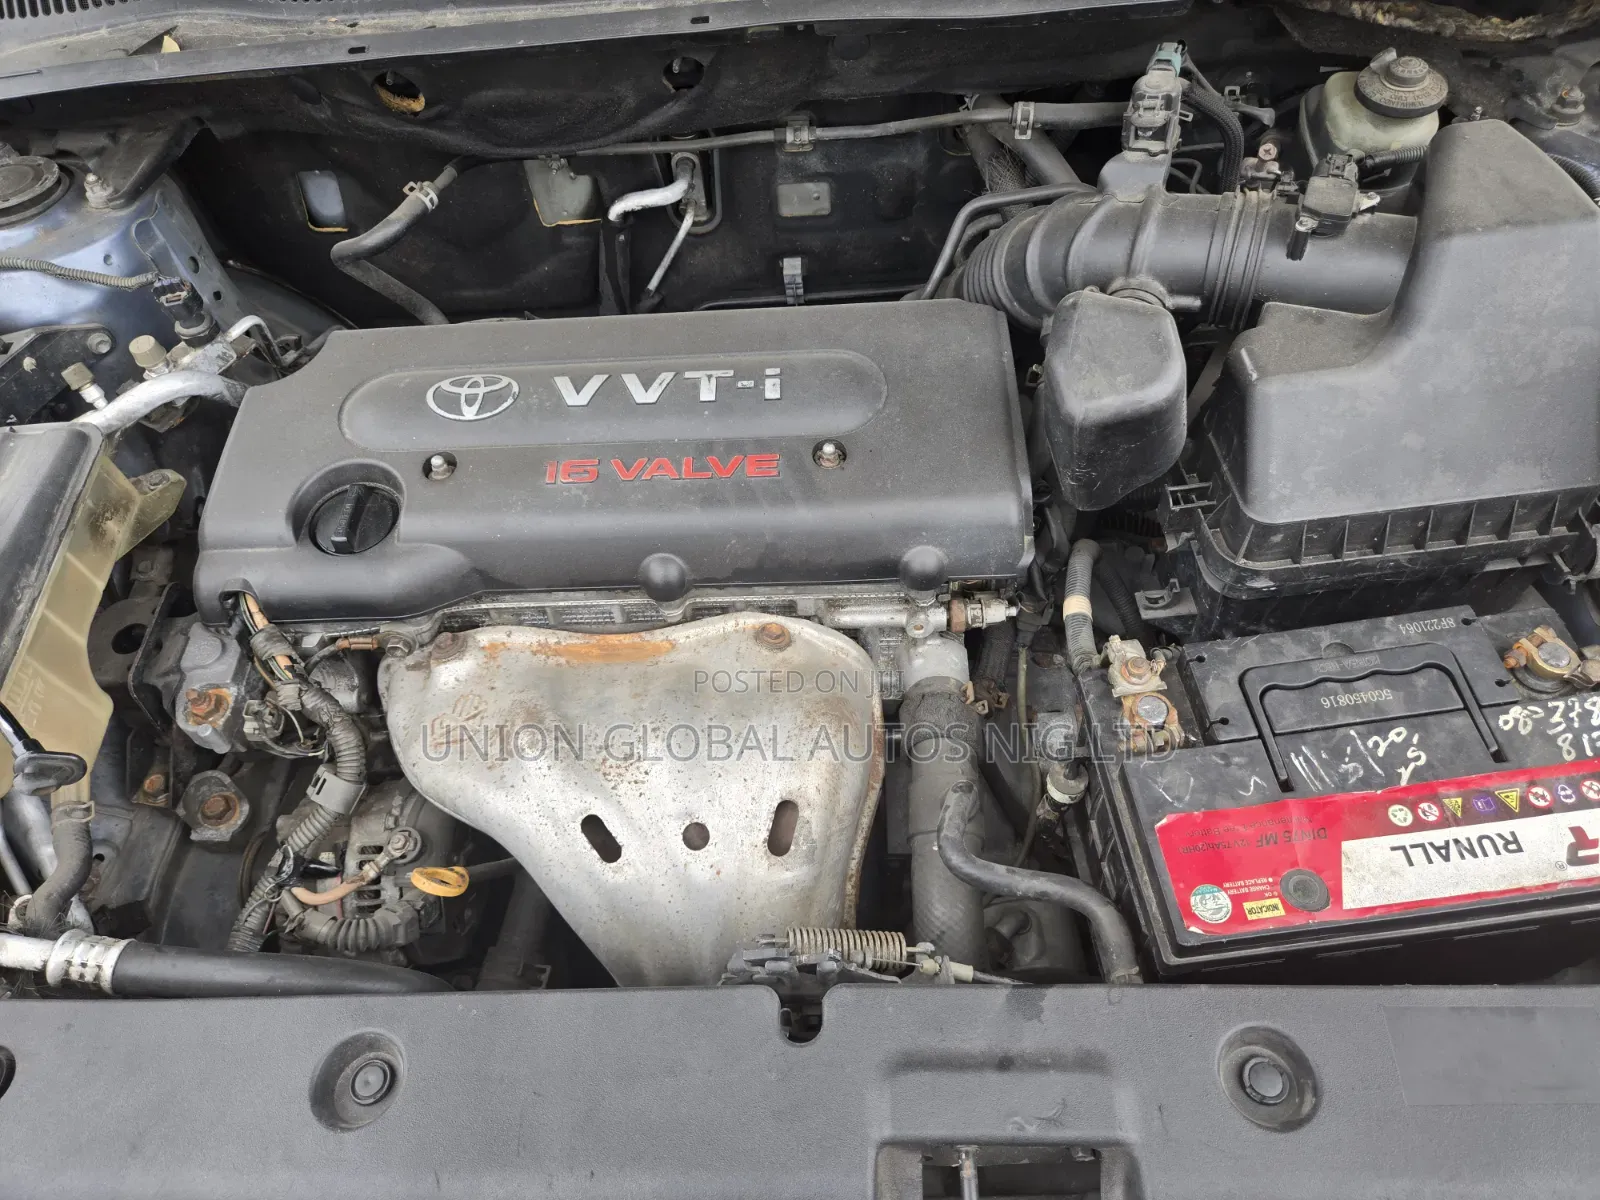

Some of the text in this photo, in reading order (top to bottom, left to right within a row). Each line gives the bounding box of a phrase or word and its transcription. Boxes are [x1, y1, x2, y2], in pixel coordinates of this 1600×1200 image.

[552, 367, 782, 407] VVT-i
[544, 453, 781, 484] 16 VALVE
[1399, 617, 1456, 635] 8F221064
[1320, 688, 1393, 709] 5G0450816
[1255, 833, 1279, 848] MF
[1389, 830, 1525, 867] RUNALL
[1246, 903, 1280, 915] INDICATOR
